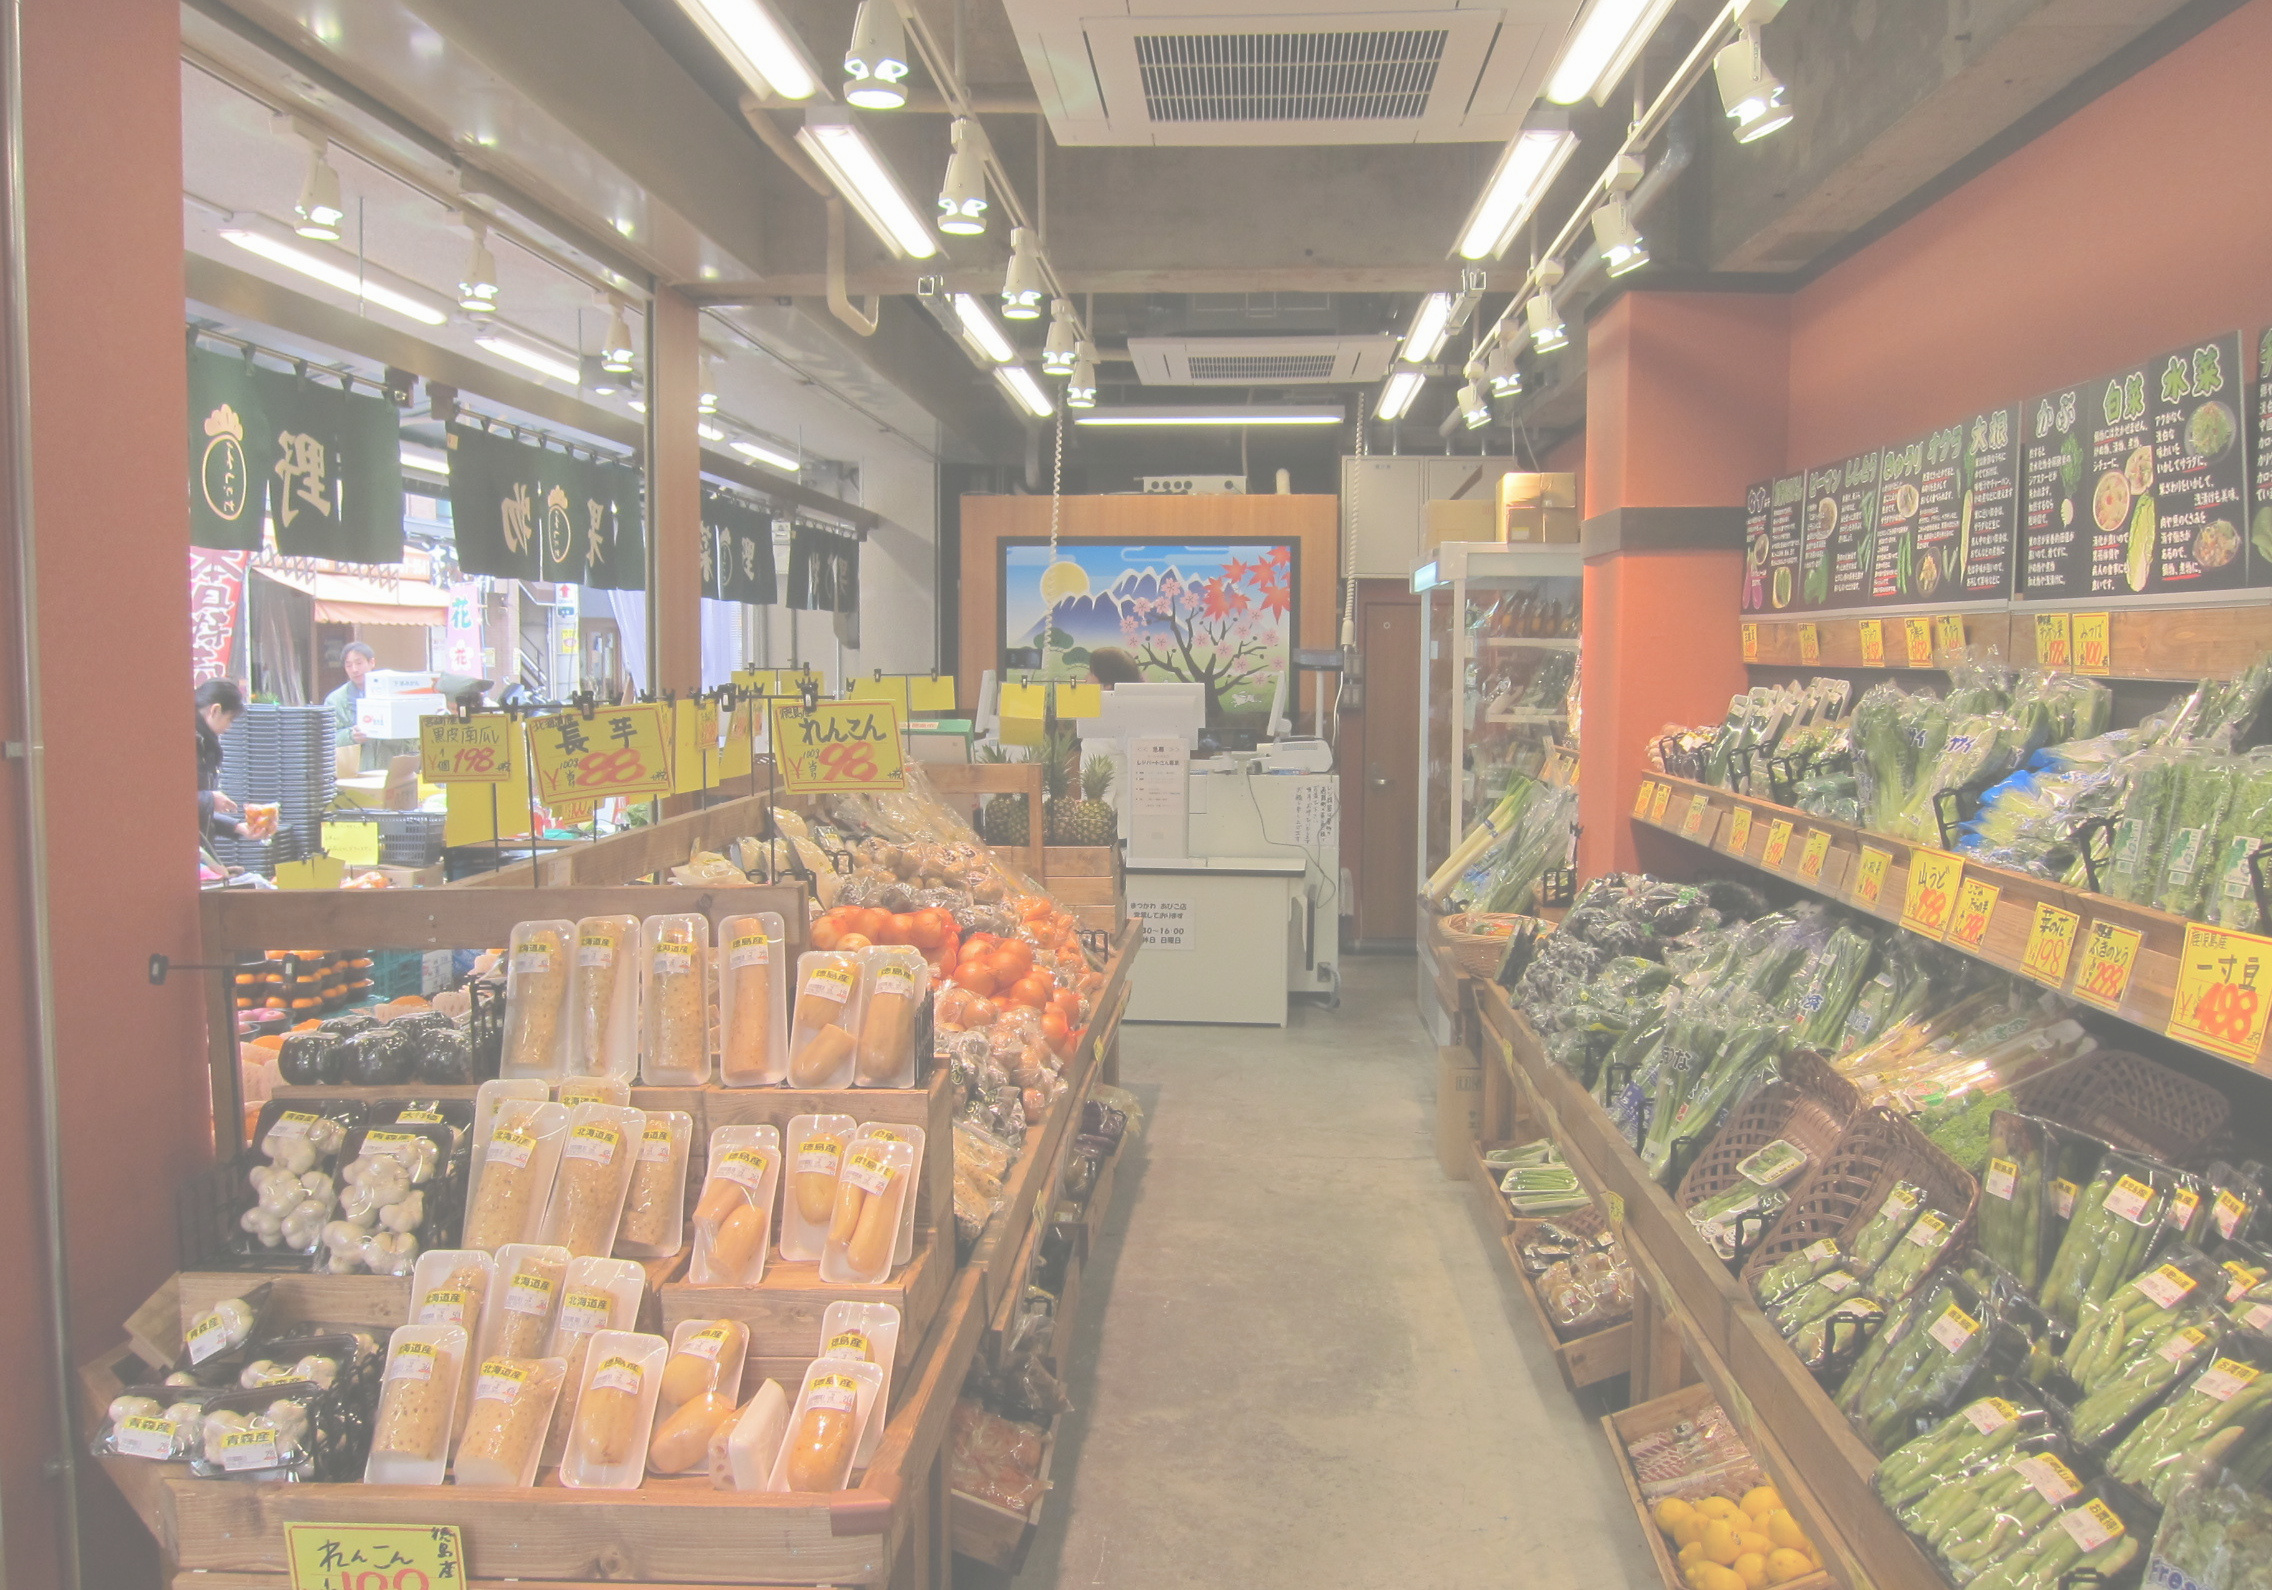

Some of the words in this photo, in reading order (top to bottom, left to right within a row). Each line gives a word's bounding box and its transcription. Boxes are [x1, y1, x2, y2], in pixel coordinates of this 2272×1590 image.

[2161, 344, 2224, 404] 水菜
[2103, 371, 2145, 426] 白菜
[2035, 391, 2076, 438] かぶ
[1970, 409, 2009, 455] 大根
[451, 597, 472, 629] 花
[431, 725, 500, 746] 黒皮南瓜
[798, 714, 887, 745] れんこん
[453, 747, 496, 773] 198
[575, 747, 647, 787] 88
[818, 740, 879, 781] 98
[1918, 861, 1950, 889] 山うど
[2040, 908, 2069, 937] 菜の花
[731, 937, 764, 947] 徳島産
[2089, 937, 2129, 965] ふきのとう
[2087, 961, 2125, 999] 298
[2197, 954, 2260, 992] 一寸豆
[577, 1128, 615, 1143] 北海道産
[802, 1143, 837, 1154] 徳島産
[727, 1151, 763, 1166] 徳島産
[568, 1295, 607, 1310] 北海道産
[831, 1338, 863, 1349] 徳島産
[482, 1364, 521, 1379] 北海道産
[128, 1417, 171, 1433] 青森産
[227, 1432, 270, 1447] 青森産
[318, 1539, 415, 1572] れんこん
